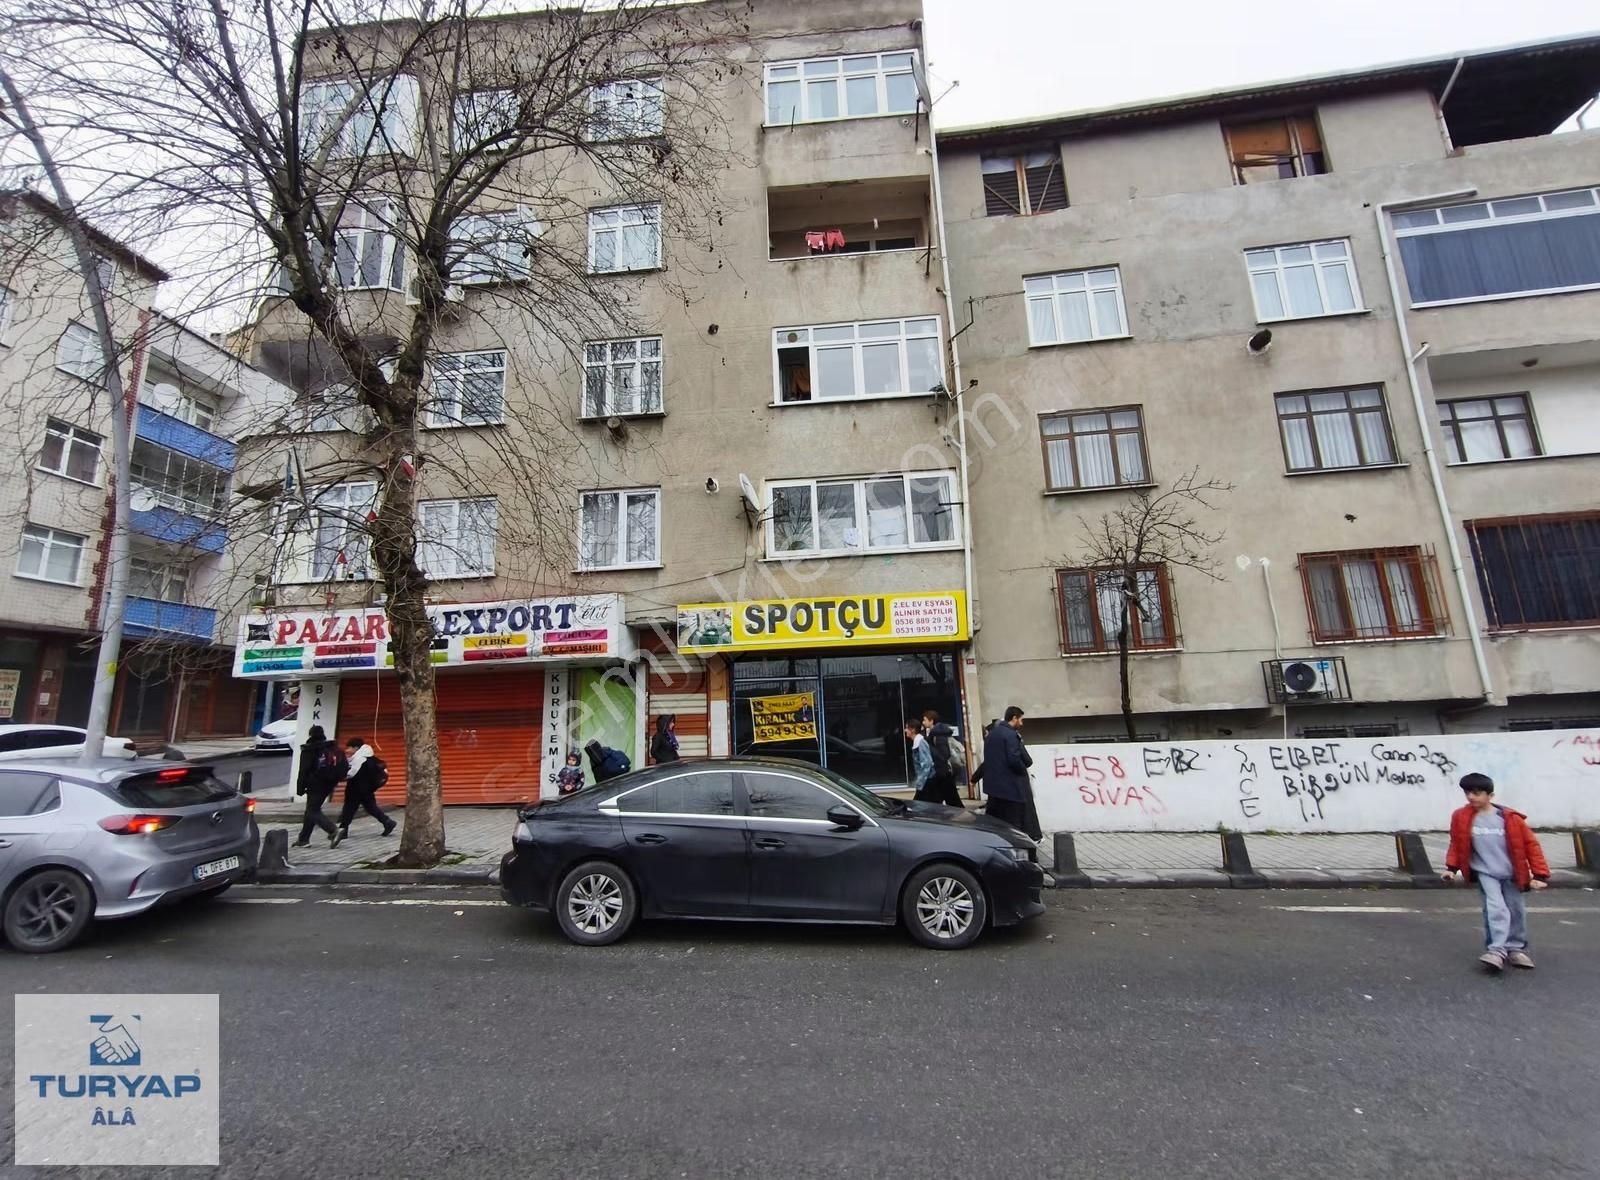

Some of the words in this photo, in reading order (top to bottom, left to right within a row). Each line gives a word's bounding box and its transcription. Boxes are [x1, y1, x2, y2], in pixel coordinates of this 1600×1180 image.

[894, 609, 921, 617] ALINIR
[922, 607, 953, 616] SATILIR
[745, 598, 884, 638] SPOTÇU
[895, 618, 914, 626] 0536
[275, 614, 393, 645] PAZAR
[442, 603, 577, 636] EXPORT
[944, 624, 954, 632] 79
[199, 864, 208, 877] 34
